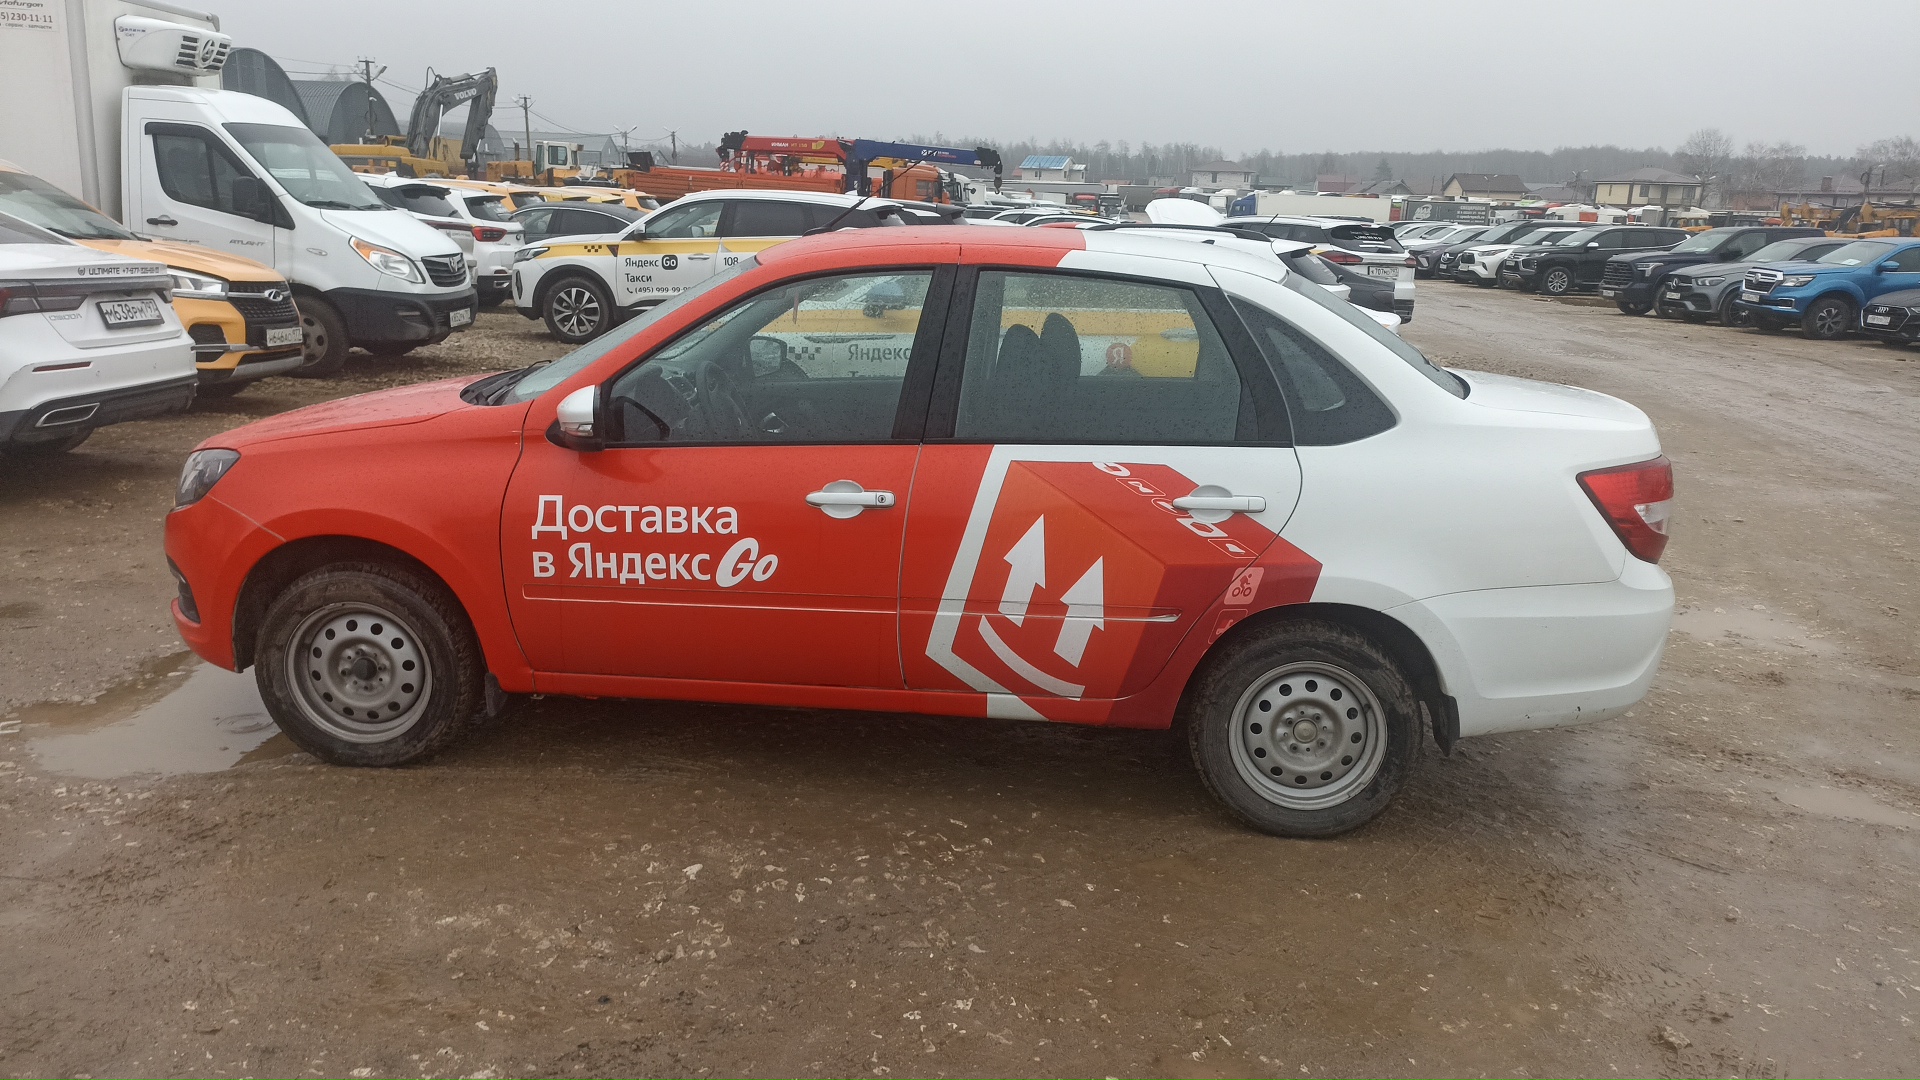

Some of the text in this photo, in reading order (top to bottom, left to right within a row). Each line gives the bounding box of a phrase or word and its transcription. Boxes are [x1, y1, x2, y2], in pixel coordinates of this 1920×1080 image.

[454, 88, 477, 100] VOLVO
[624, 256, 678, 269] Яндекс Go
[723, 257, 739, 266] 108
[88, 267, 120, 276] ULTIMATE
[625, 273, 652, 283] Такси
[531, 494, 738, 540] Доставка
[532, 537, 779, 587] в Яндекс Go
